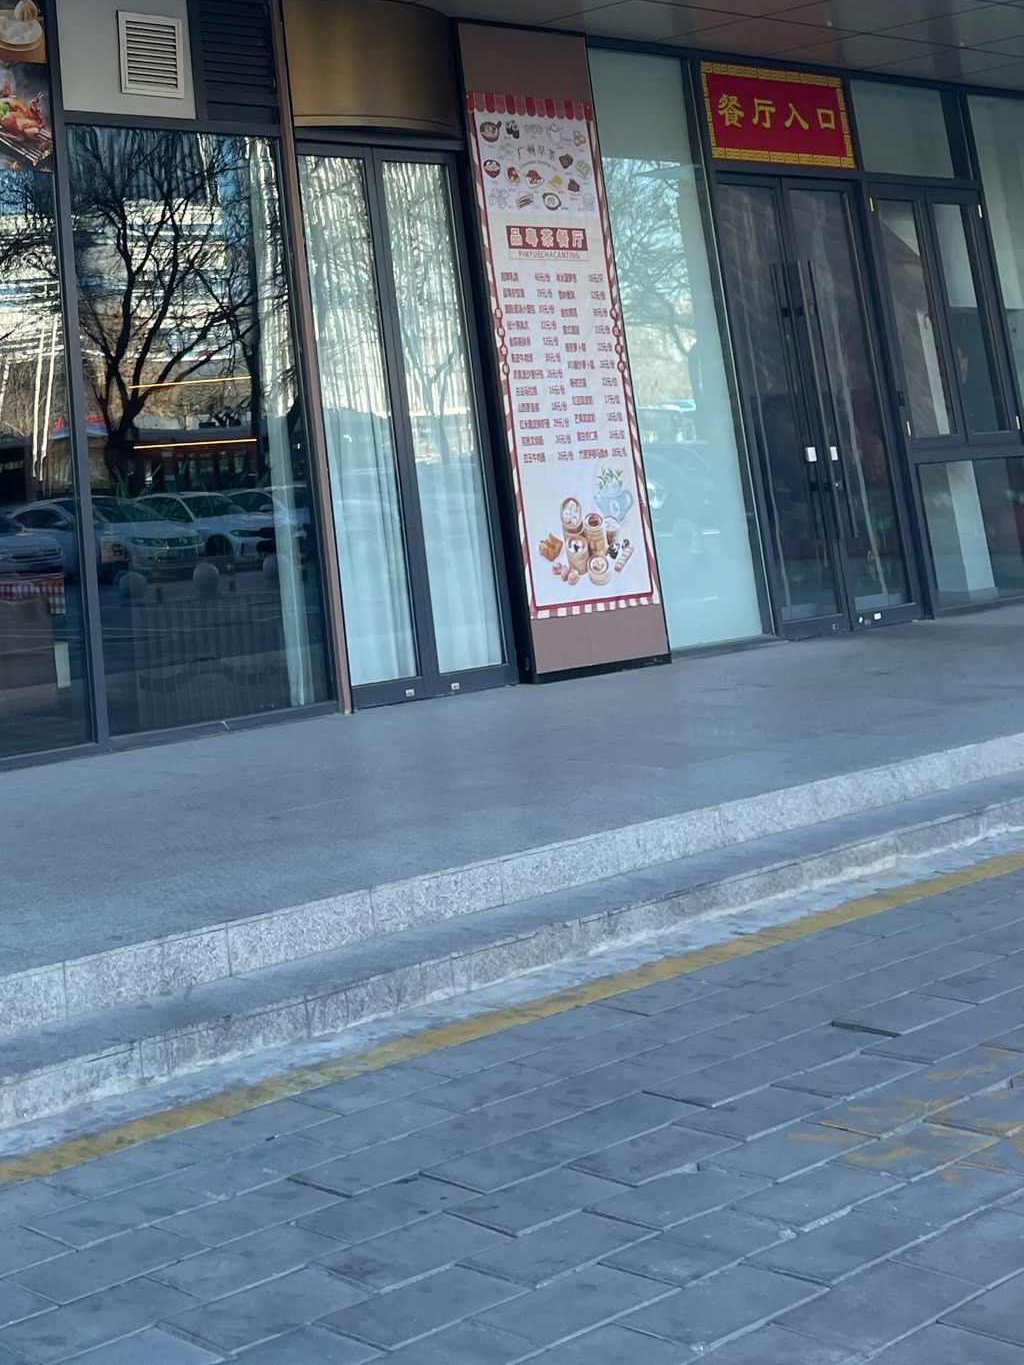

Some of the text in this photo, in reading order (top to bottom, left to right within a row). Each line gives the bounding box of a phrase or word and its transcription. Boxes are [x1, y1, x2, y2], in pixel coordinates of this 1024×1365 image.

[718, 94, 835, 130] 餐厅入口
[517, 144, 555, 162] 广州早茶
[510, 228, 584, 248] 品粤茶餐厅
[518, 250, 580, 259] PINYUECHACANTING
